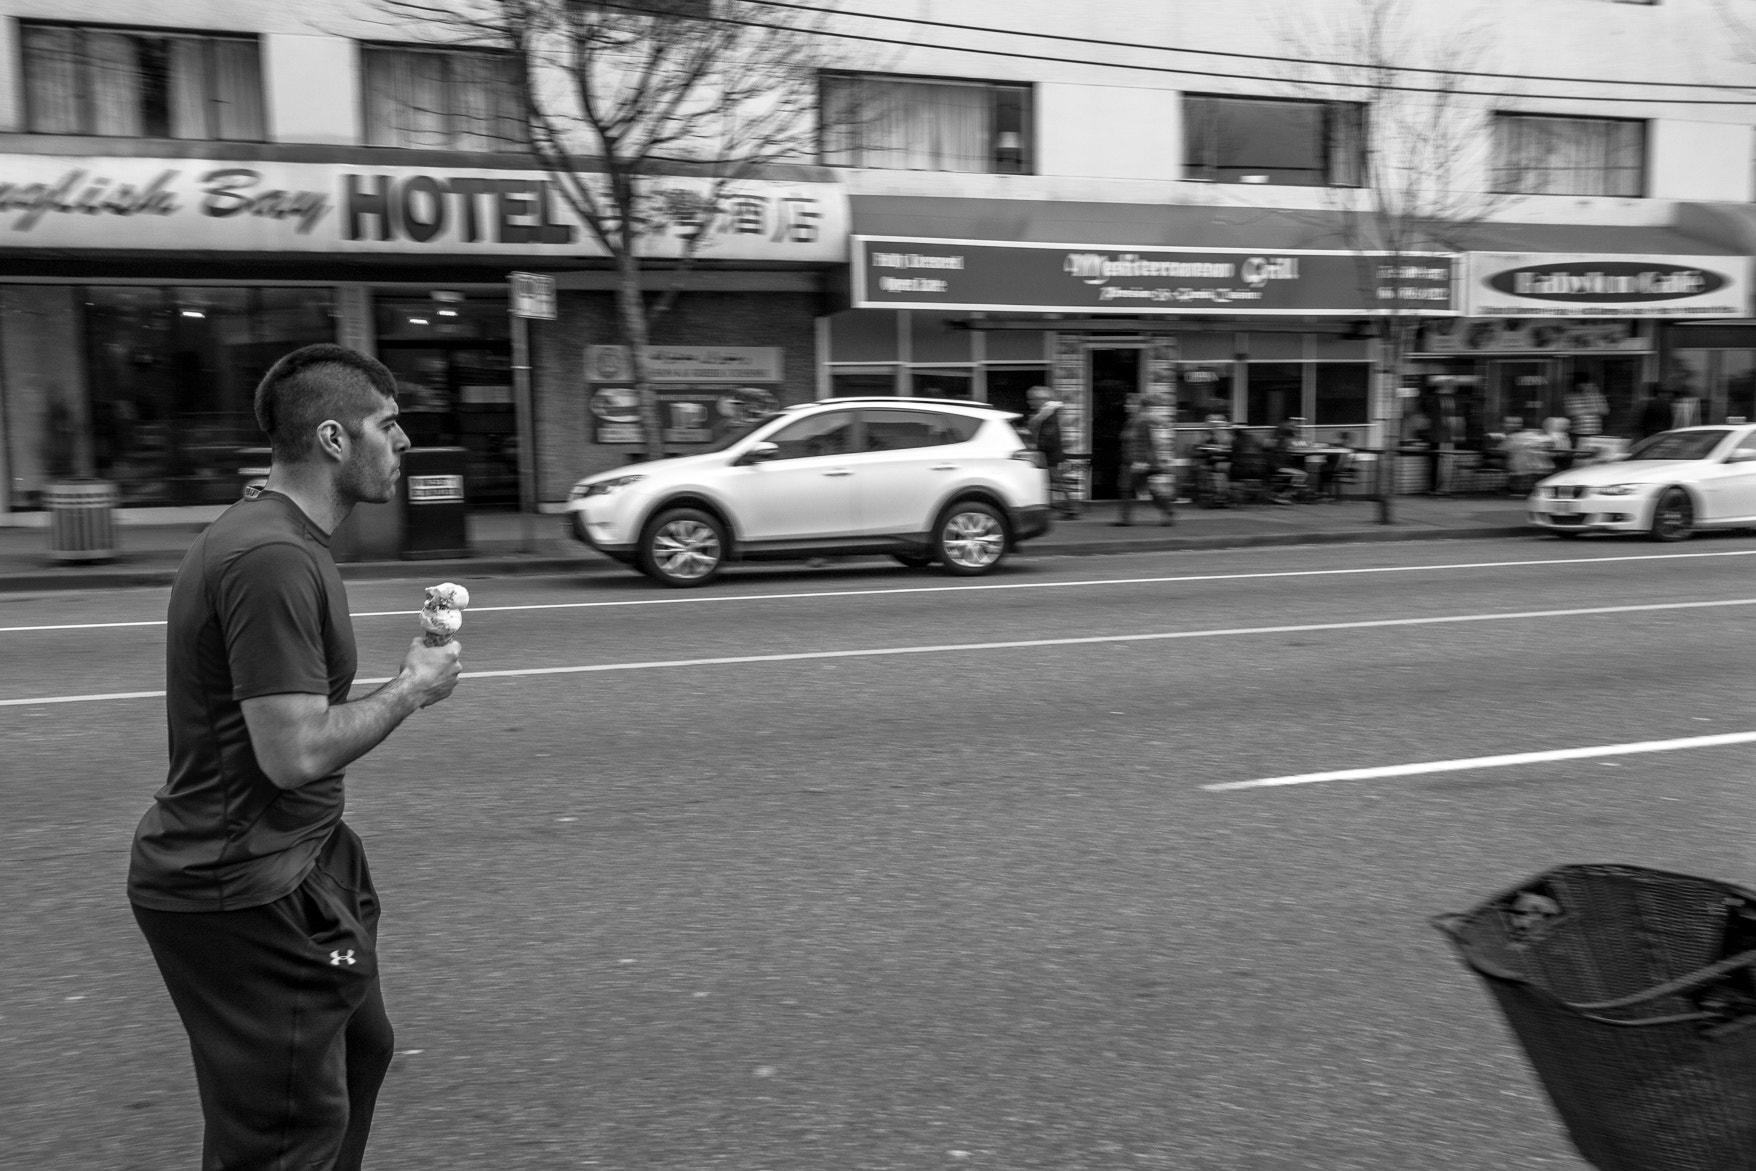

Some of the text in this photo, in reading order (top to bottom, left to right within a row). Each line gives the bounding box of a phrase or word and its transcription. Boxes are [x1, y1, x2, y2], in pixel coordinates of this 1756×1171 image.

[198, 168, 333, 235] Bay
[341, 173, 577, 245] HOTEL
[1240, 256, 1300, 287] Grill
